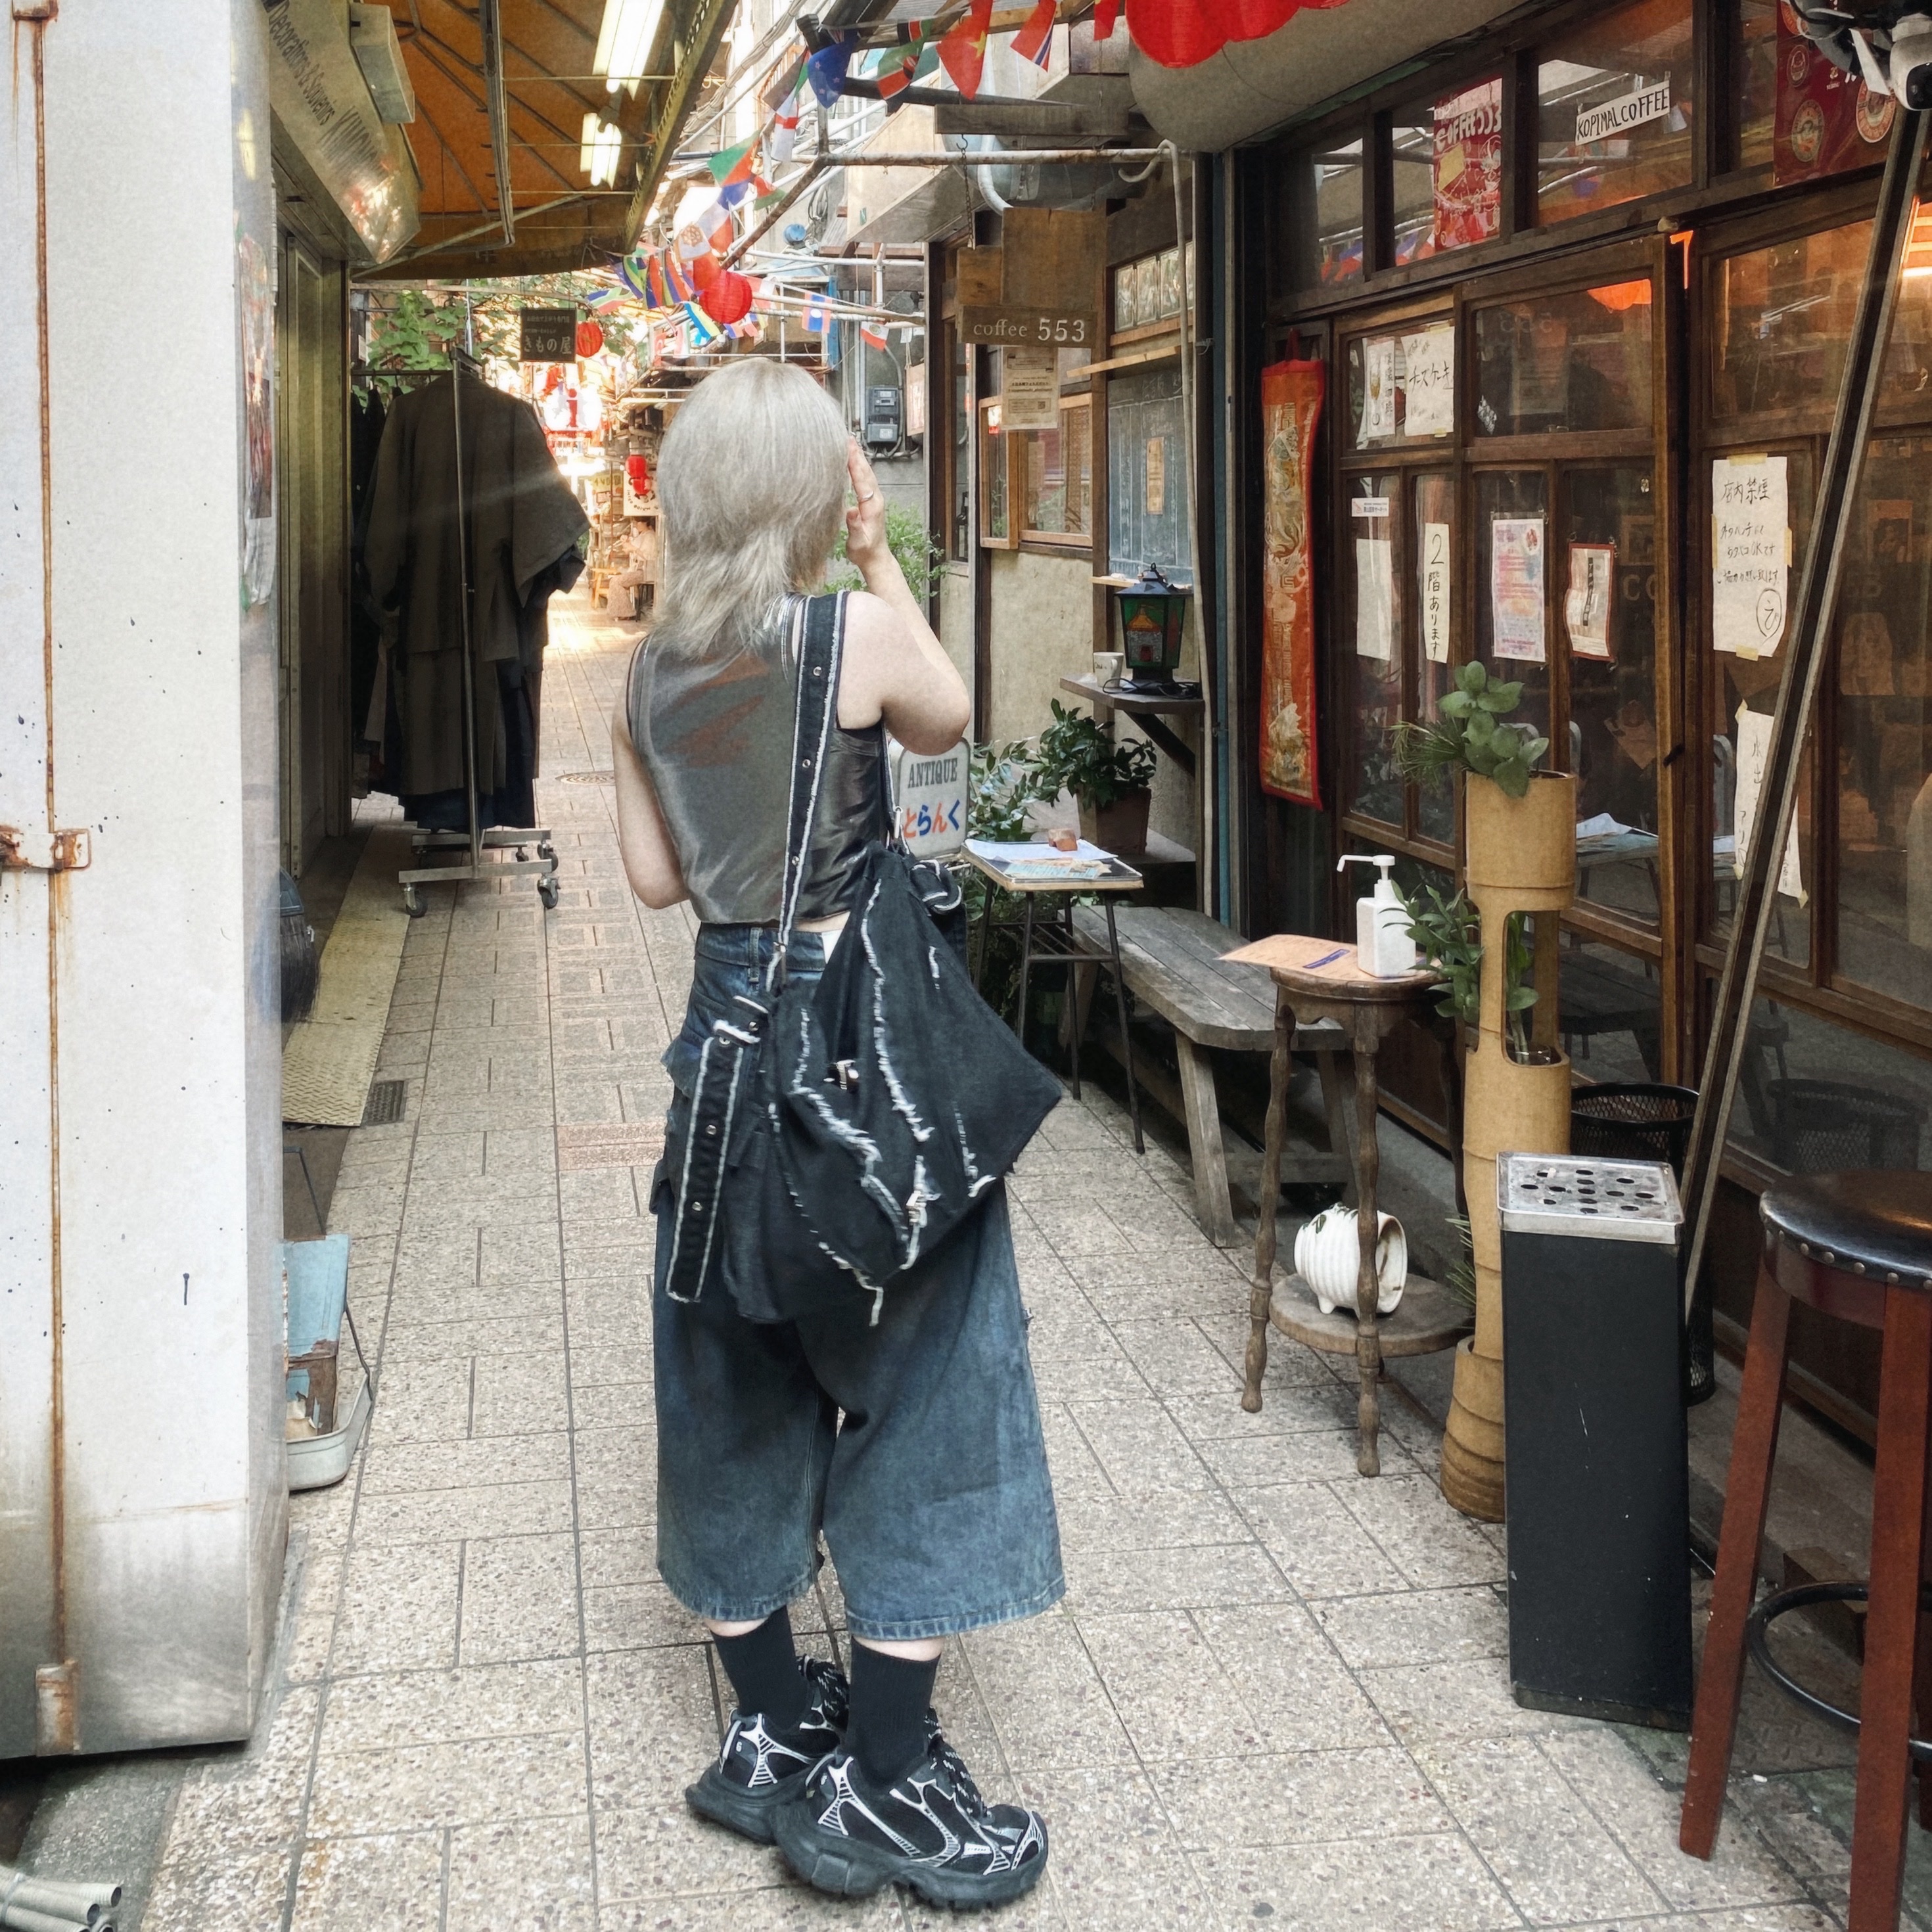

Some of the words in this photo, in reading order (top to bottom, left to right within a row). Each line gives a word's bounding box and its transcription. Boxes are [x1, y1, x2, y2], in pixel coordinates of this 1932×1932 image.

[269, 0, 311, 80] Decorations
[303, 71, 336, 126] Souvenirs
[524, 335, 572, 355] きもの屋
[973, 319, 1028, 337] coffee
[1037, 317, 1085, 342] 553
[1721, 476, 1771, 505] 店内禁煙
[1427, 534, 1444, 659] 2階あります
[908, 757, 958, 789] ANTIQUE
[903, 798, 961, 839] とらんく
